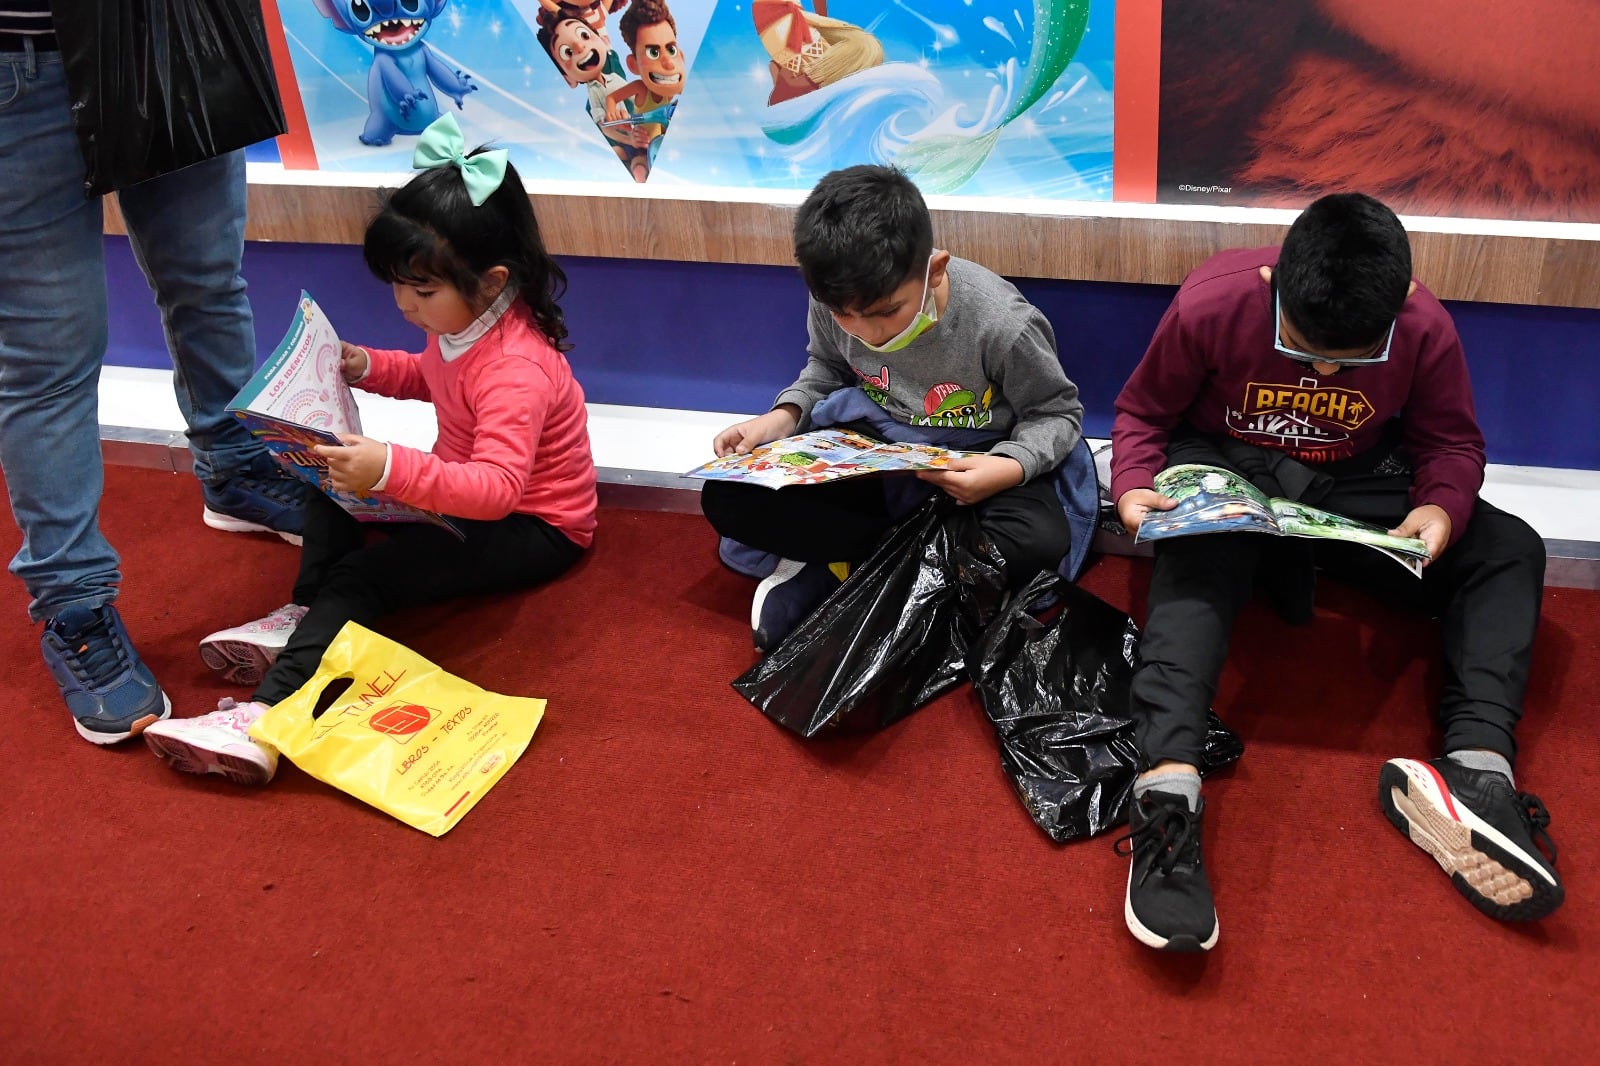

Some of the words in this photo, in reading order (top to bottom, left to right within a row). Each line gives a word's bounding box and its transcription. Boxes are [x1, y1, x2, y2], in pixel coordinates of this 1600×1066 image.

[268, 380, 285, 398] LOS
[1255, 388, 1348, 421] BEACH
[337, 669, 407, 717] TUNEL
[440, 706, 472, 735] TEXTOS
